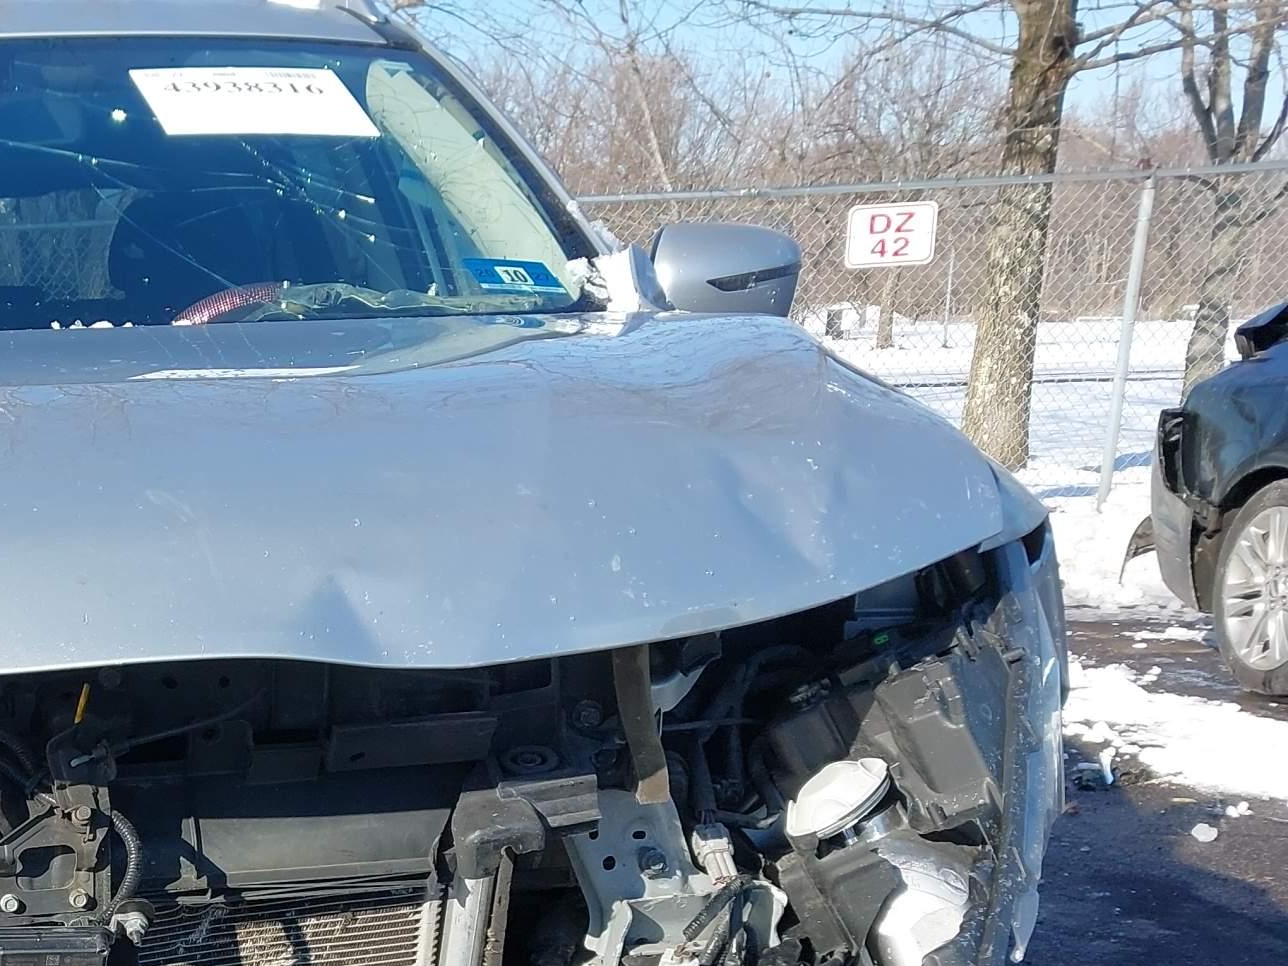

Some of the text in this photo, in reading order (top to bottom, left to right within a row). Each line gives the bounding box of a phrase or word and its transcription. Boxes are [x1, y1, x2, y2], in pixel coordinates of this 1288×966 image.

[164, 80, 325, 95] 43938316
[870, 212, 915, 234] DZ
[870, 237, 910, 257] 42
[502, 269, 528, 283] 10
